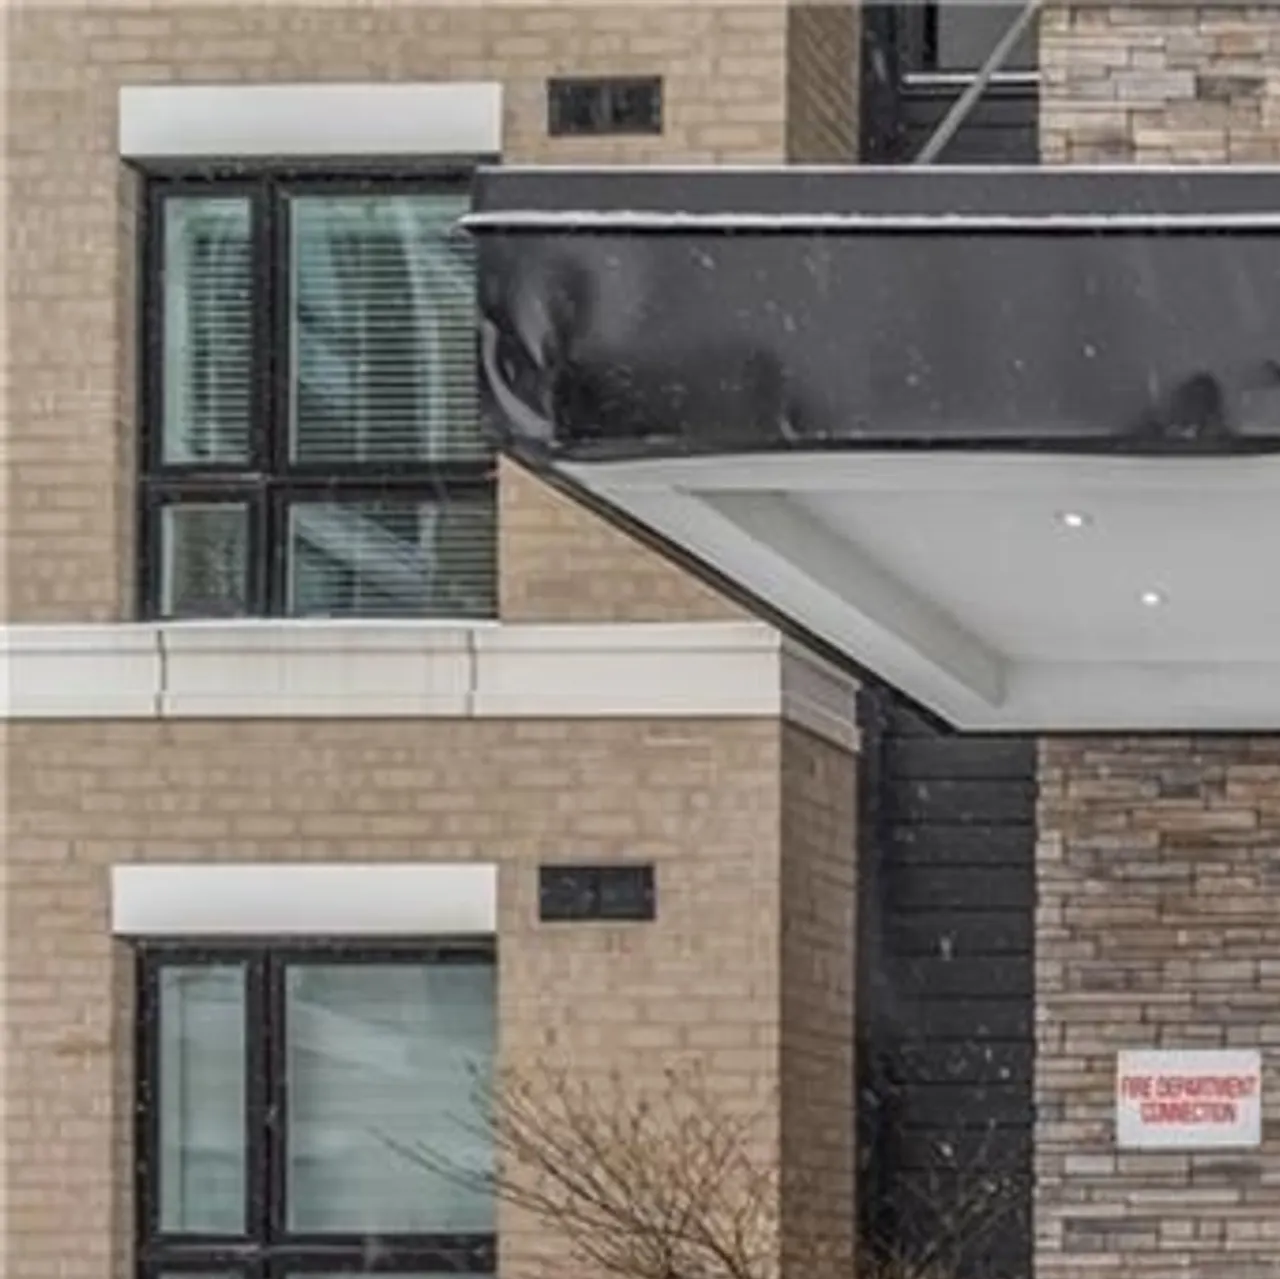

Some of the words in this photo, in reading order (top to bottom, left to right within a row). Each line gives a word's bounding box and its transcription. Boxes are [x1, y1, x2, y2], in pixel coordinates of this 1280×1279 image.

[1121, 1076, 1152, 1099] FIRE
[1156, 1075, 1256, 1098] DEPARTMENT
[1139, 1102, 1237, 1124] CONNECTION
